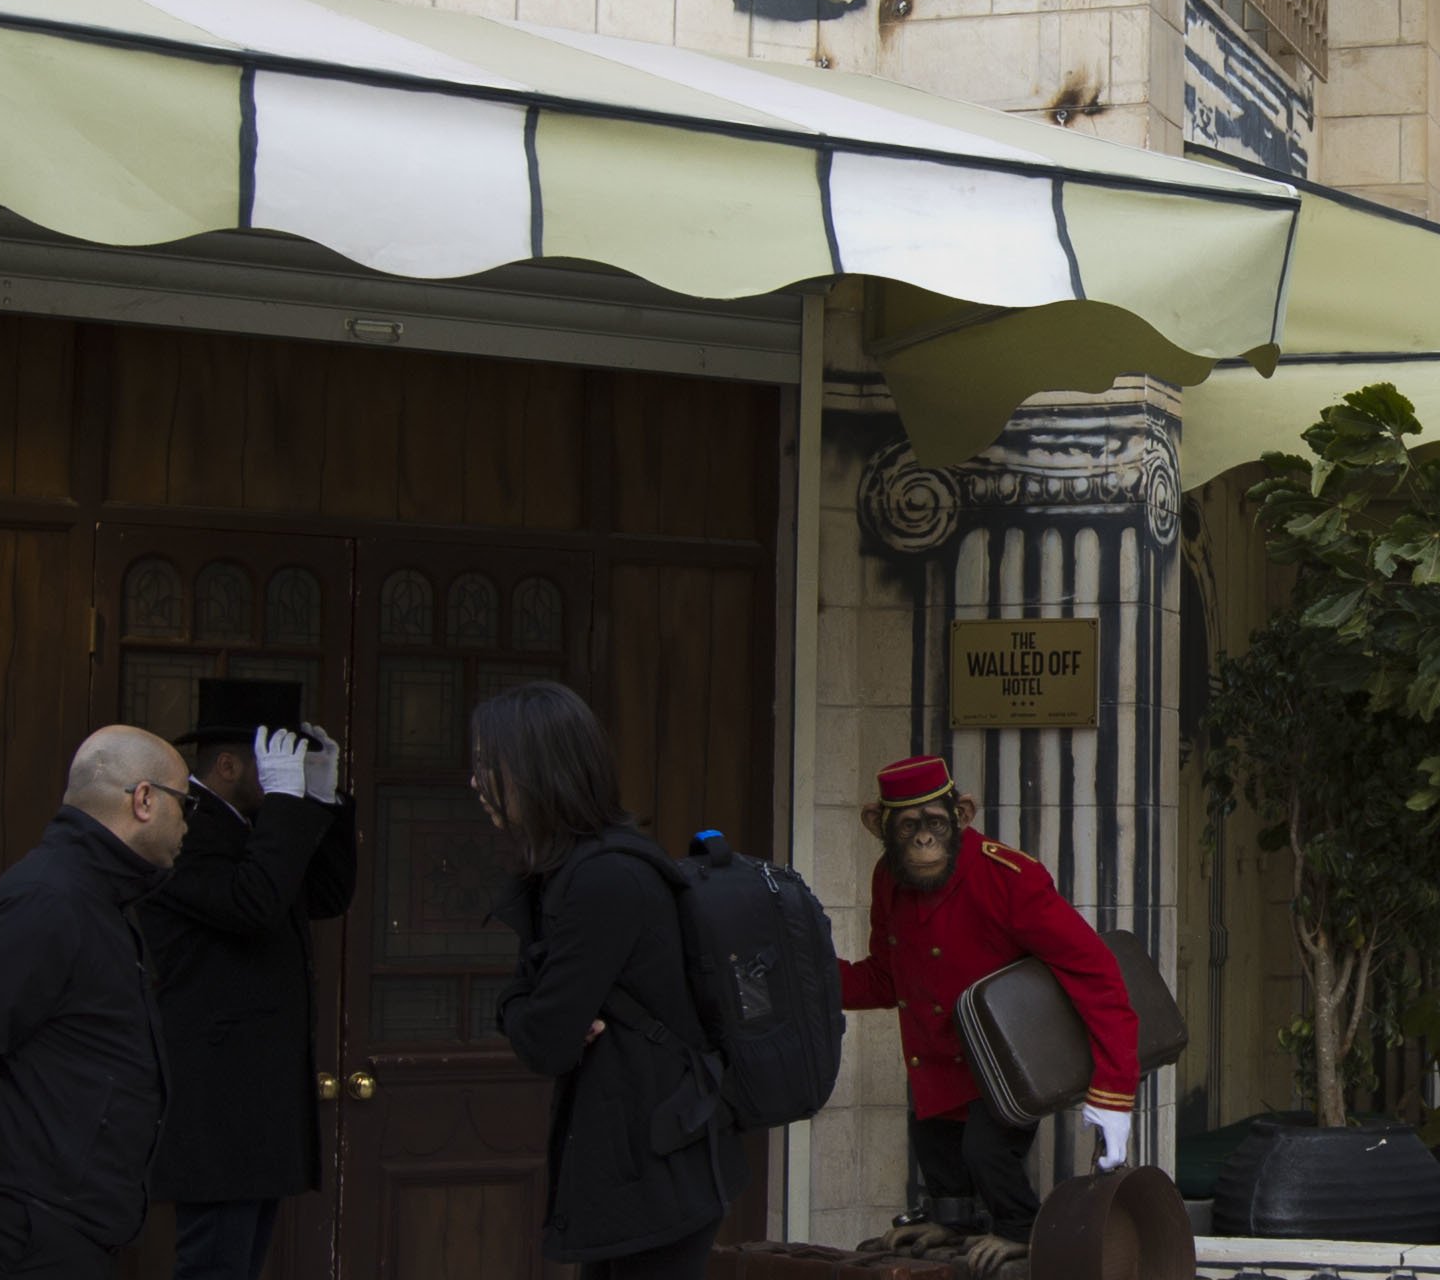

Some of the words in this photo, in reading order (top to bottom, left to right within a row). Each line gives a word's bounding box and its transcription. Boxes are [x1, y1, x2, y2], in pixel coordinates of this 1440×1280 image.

[1011, 632, 1036, 650] THE
[967, 651, 1044, 677] WALLED
[1049, 650, 1082, 676] OFF
[1002, 678, 1044, 696] HOTEL
